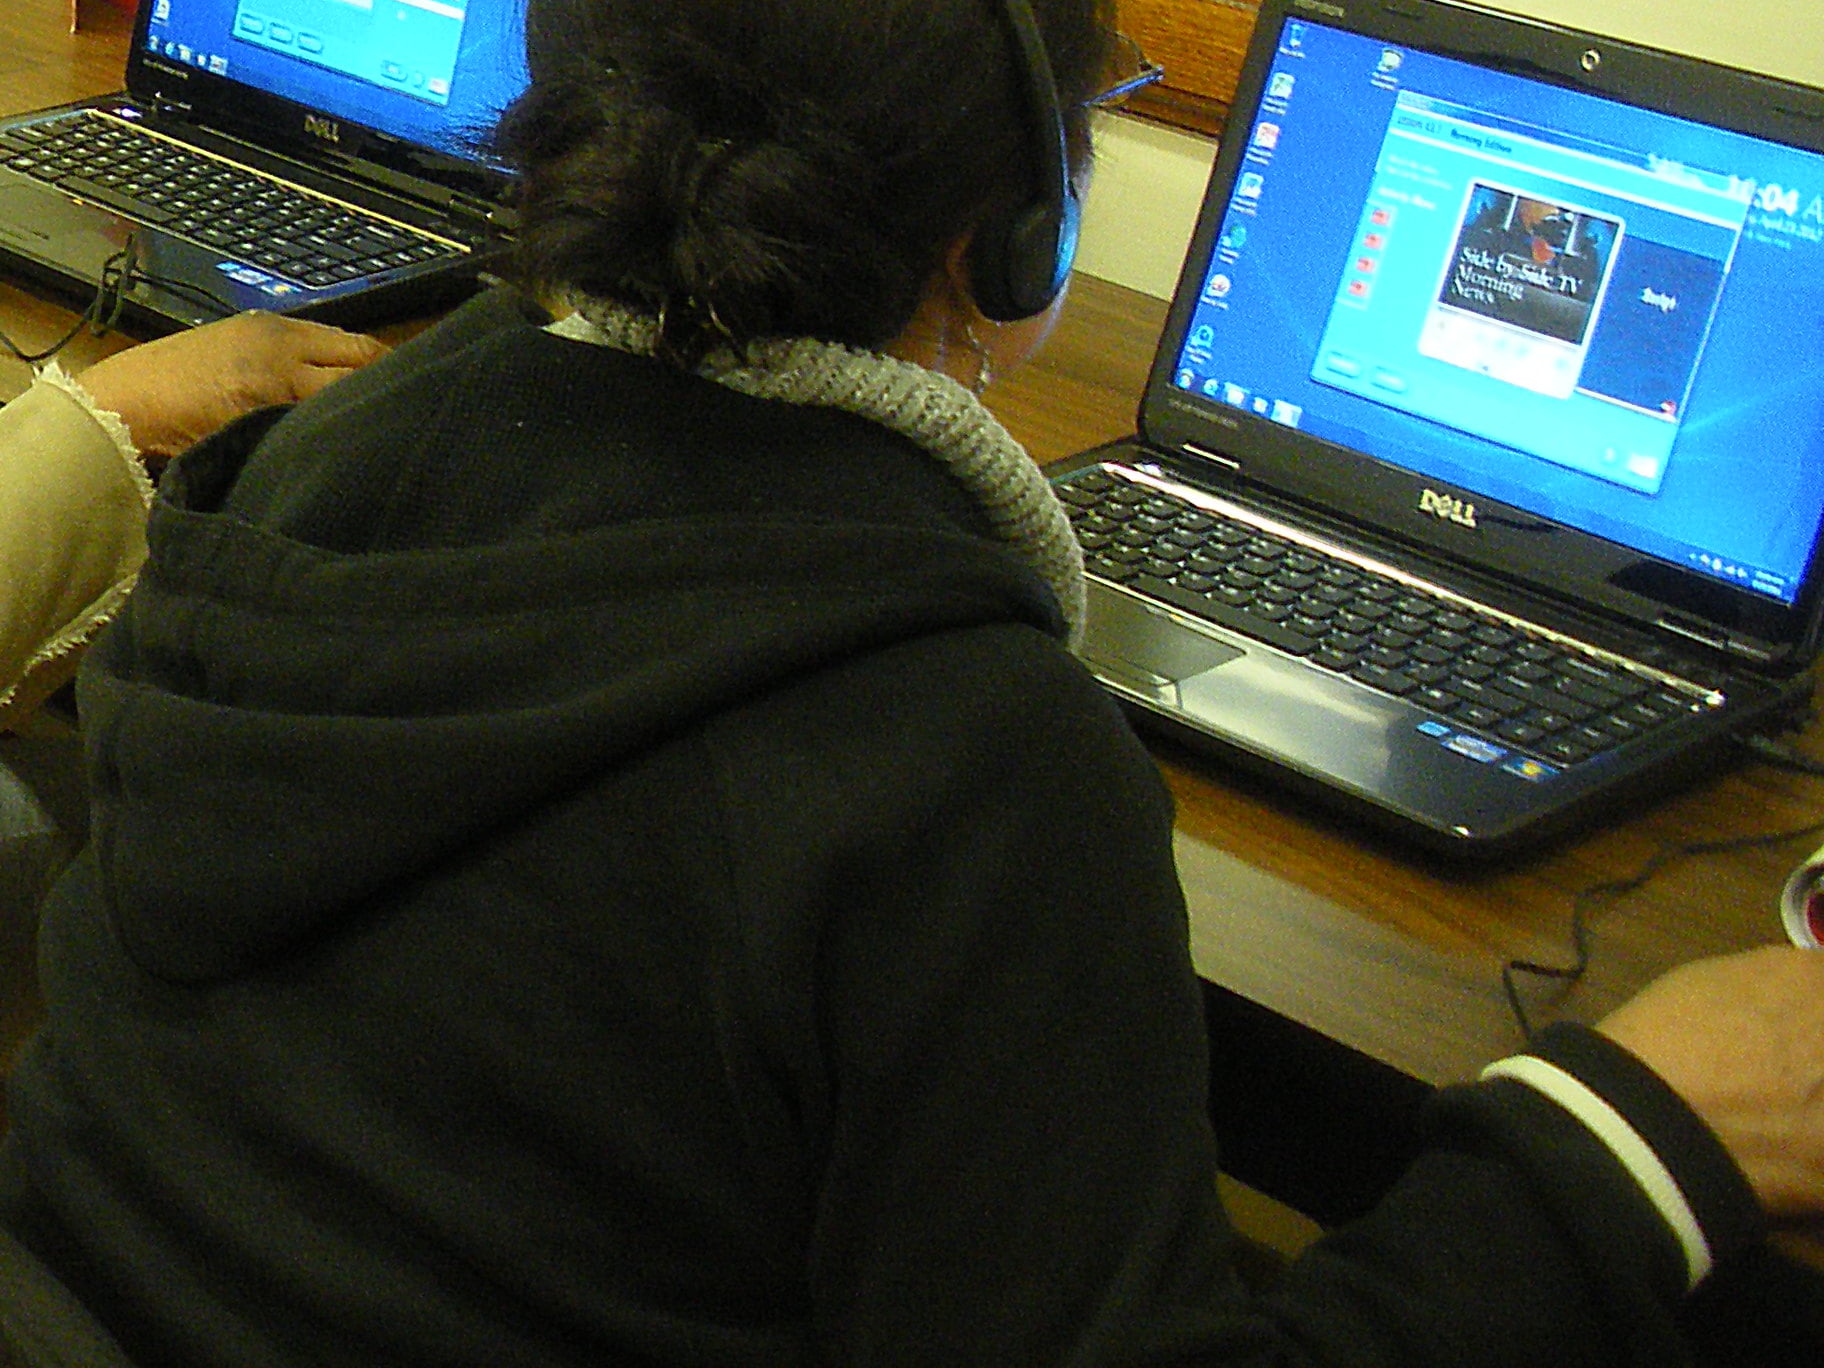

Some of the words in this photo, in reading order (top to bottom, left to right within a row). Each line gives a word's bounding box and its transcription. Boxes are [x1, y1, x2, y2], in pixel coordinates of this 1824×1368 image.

[304, 115, 340, 143] DELL
[1459, 246, 1495, 270] Side
[1496, 253, 1514, 278] by
[1518, 263, 1554, 290] Side
[1557, 275, 1583, 294] TV
[1459, 264, 1524, 300] Morning
[1418, 488, 1476, 528] DELL
